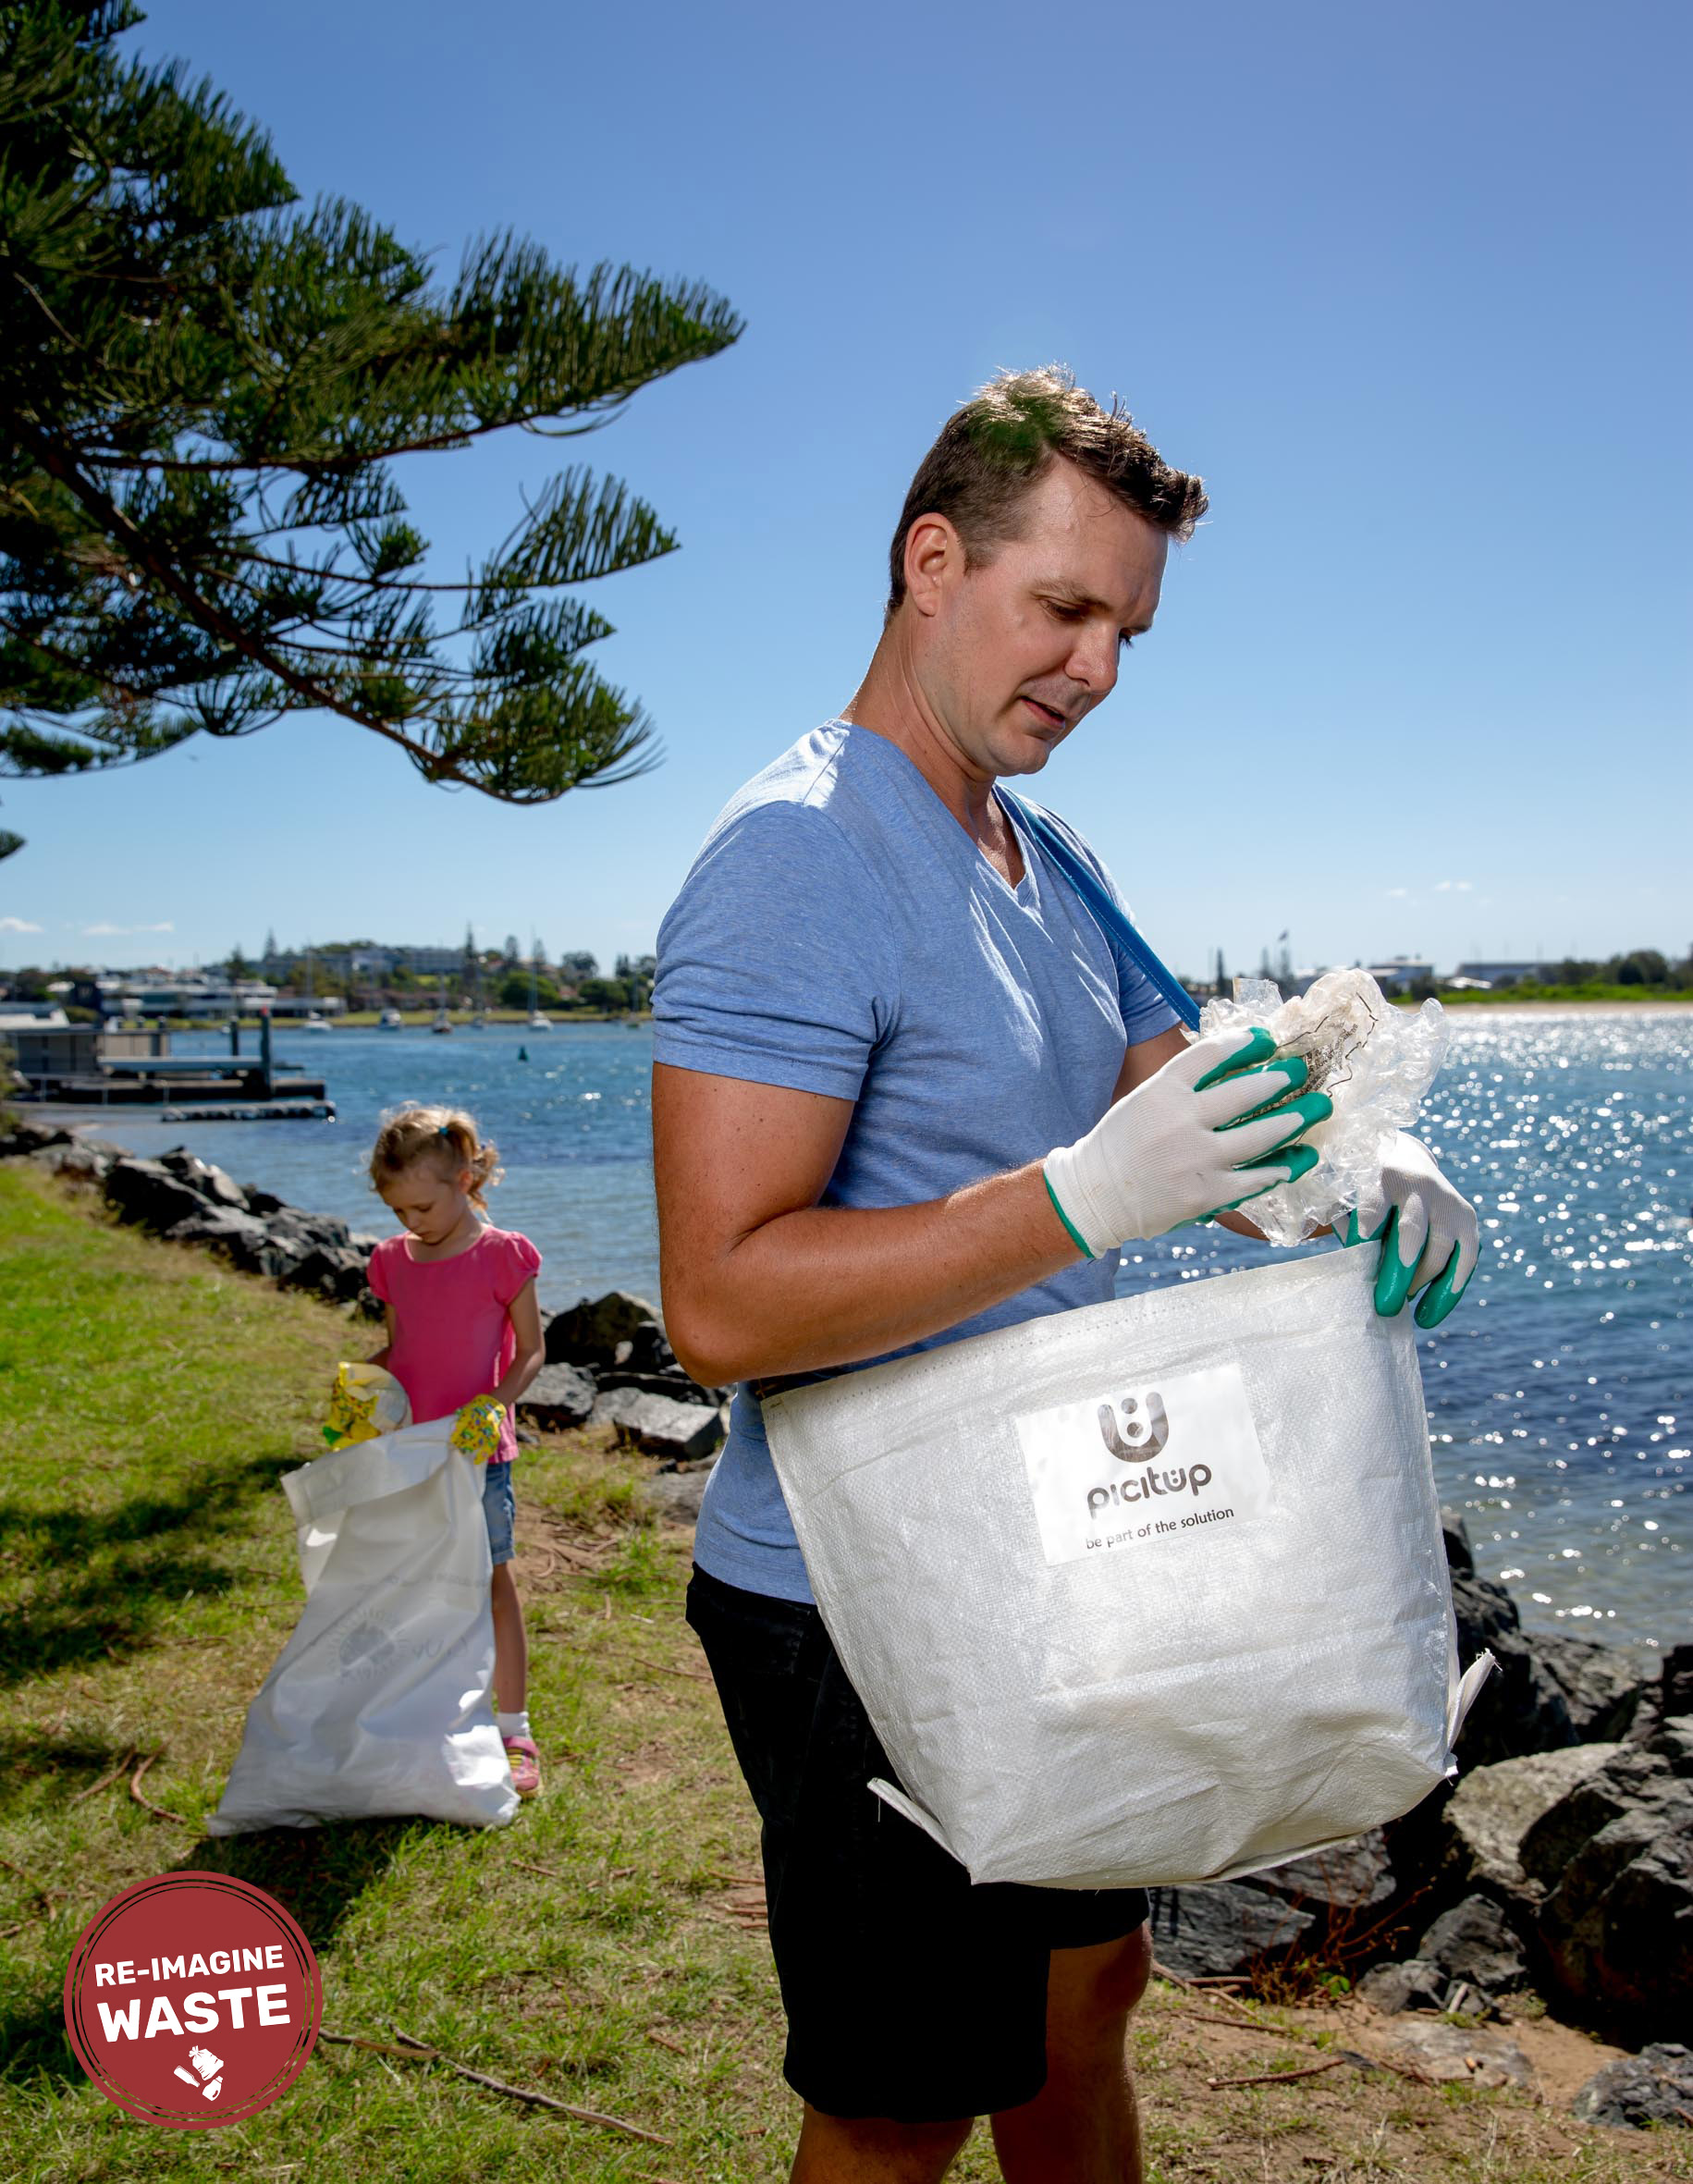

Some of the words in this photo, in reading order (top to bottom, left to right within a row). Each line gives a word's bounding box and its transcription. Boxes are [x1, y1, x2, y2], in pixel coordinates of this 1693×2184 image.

[1085, 1537, 1102, 1550] be
[1107, 1528, 1134, 1548] part
[1137, 1524, 1152, 1538] of
[1155, 1519, 1177, 1534] the
[1181, 1508, 1234, 1528] solution
